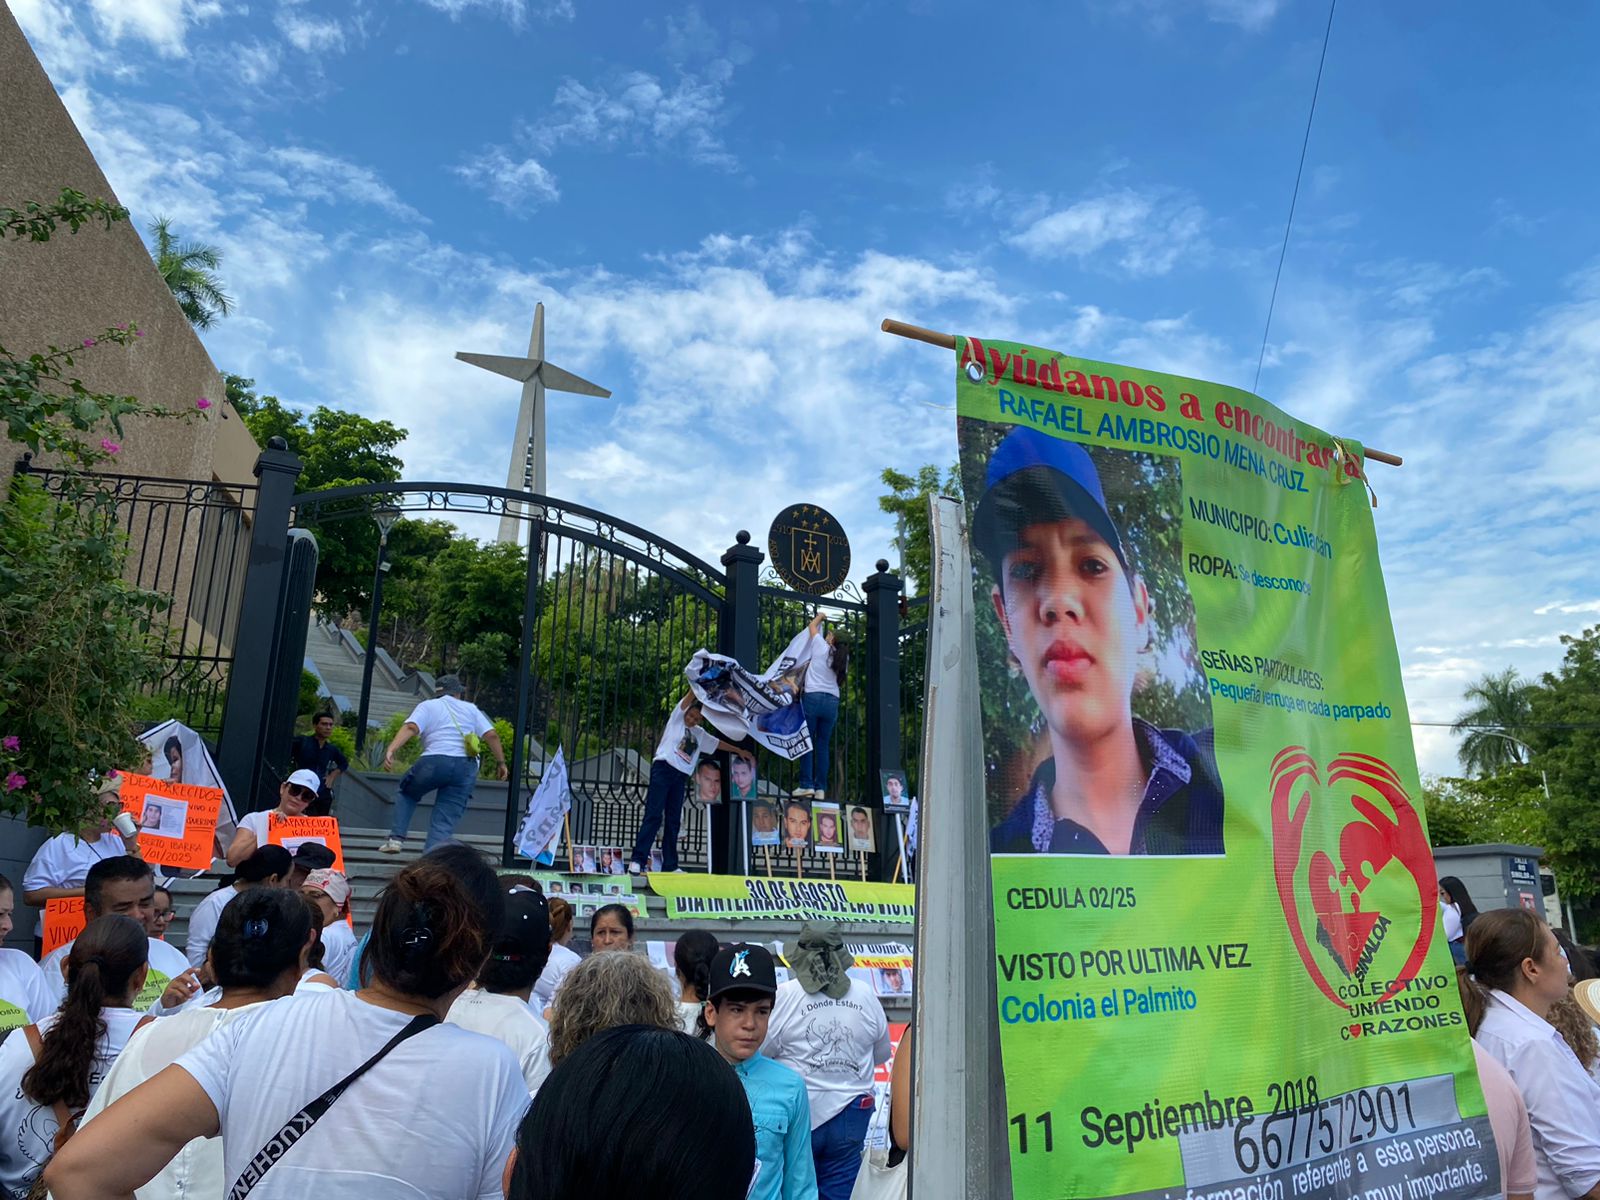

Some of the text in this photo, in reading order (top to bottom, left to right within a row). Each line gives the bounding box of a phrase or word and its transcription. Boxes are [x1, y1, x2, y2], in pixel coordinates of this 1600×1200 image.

[960, 337, 1361, 479] Ayúdanos a encontrara
[998, 388, 1309, 493] RAFAEL AMBROSIO MENA CRUZ
[1189, 497, 1332, 559] MUNICIPIO: Culiacán
[1189, 553, 1237, 580] ROPA:
[1238, 564, 1250, 583] Se
[1201, 649, 1324, 691] SEÑAS PARTICULARES:
[1209, 677, 1392, 722] Pequeña verruga en cada parpado
[788, 881, 848, 903] AGOSTO
[1006, 886, 1136, 910] CEDULA 02/25
[998, 943, 1252, 982] VISTO POR ULTIMA VEZ
[1354, 915, 1392, 984] SINALOA
[1001, 985, 1197, 1024] Colonia el Palmito
[1338, 974, 1449, 1000] COLECTIVO
[1350, 994, 1441, 1018] UNIENDO
[1010, 1075, 1320, 1153] 11 Septiembre 2018
[1292, 1154, 1351, 1196] referente
[1356, 1152, 1369, 1173] a
[1375, 1138, 1414, 1168] esta
[1414, 1127, 1482, 1165] persona,
[1404, 1159, 1488, 1200] importante.
